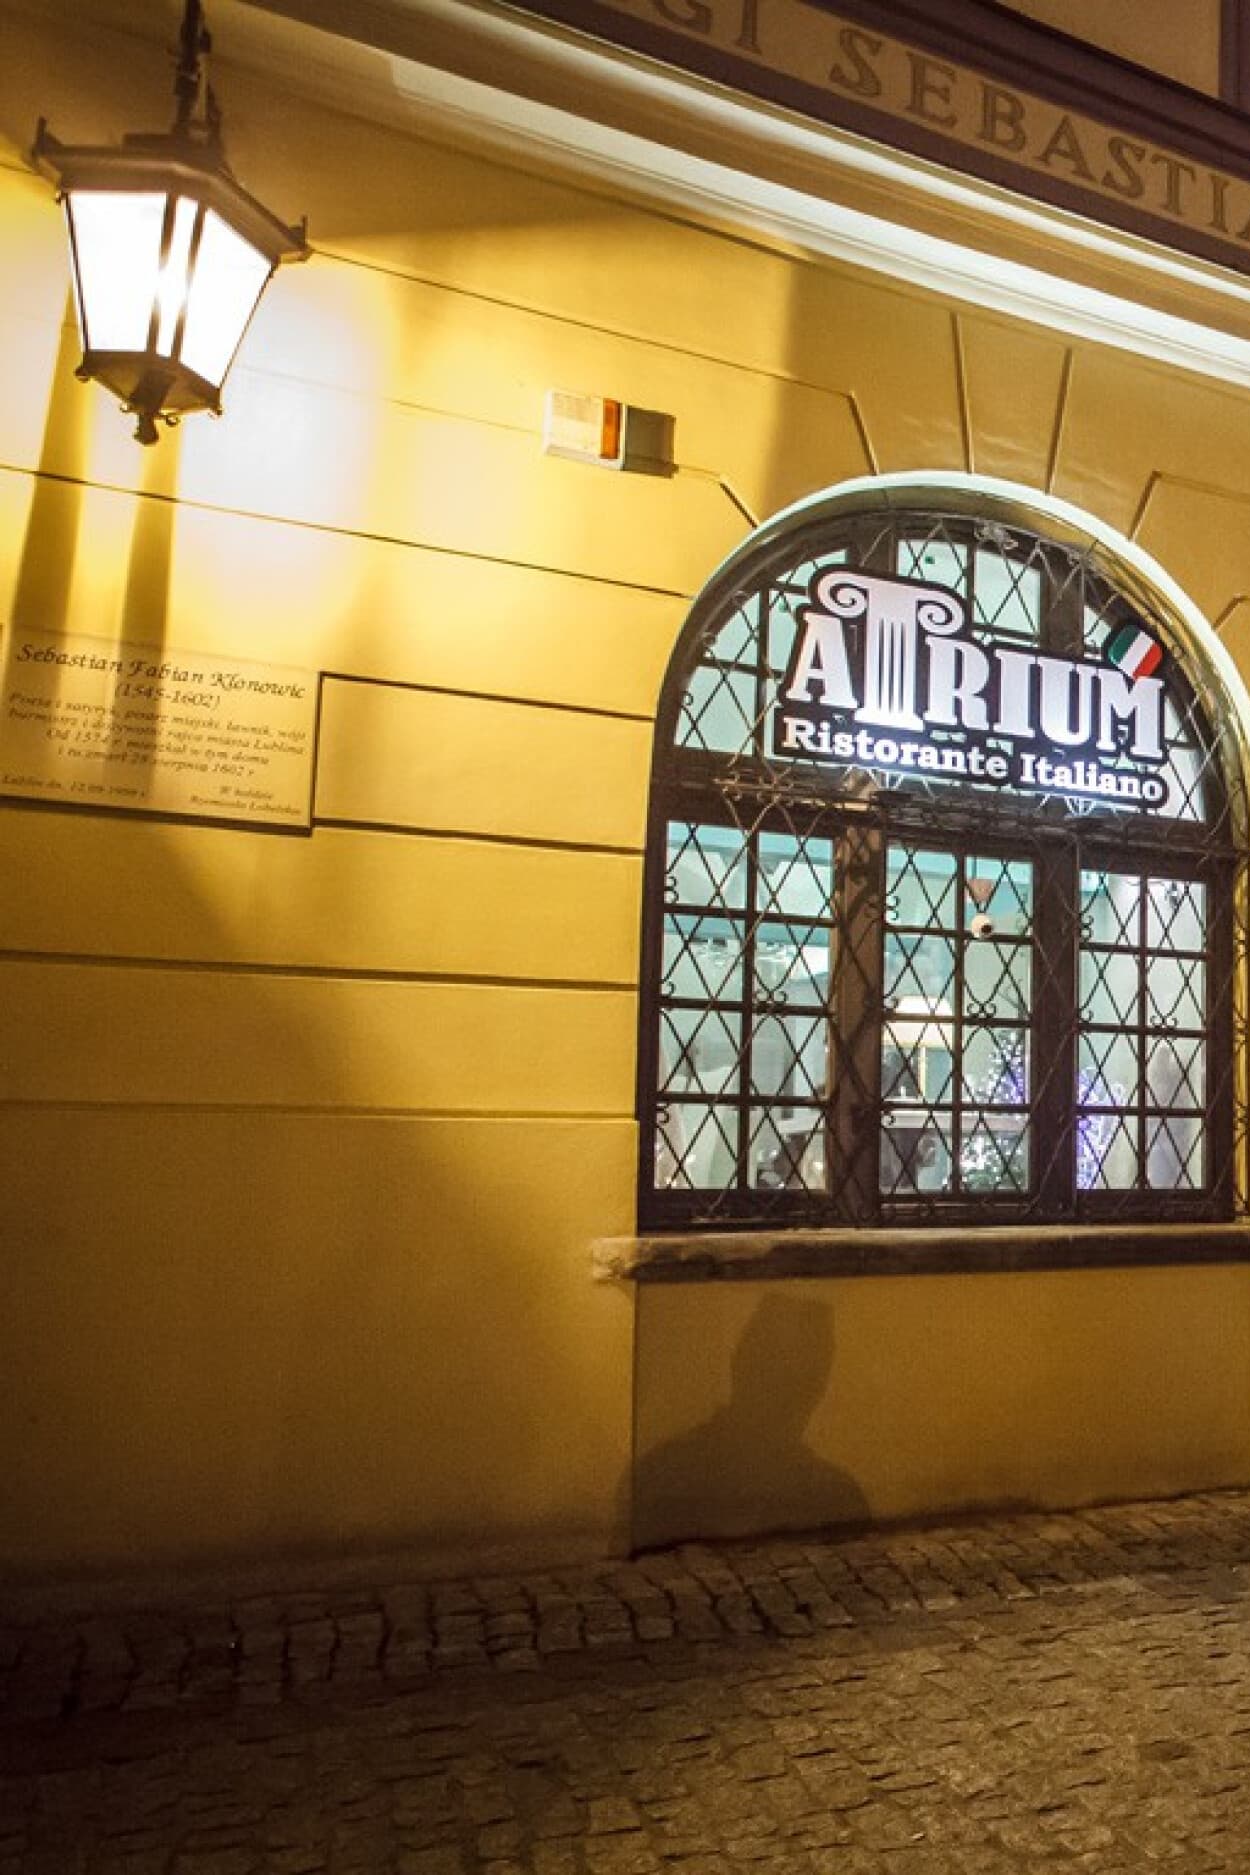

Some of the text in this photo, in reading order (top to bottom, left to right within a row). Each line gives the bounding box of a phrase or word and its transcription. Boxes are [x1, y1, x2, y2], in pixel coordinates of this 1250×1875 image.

[16, 643, 306, 699] Sebastian Fabian Klonowic
[115, 682, 221, 710] (1545-1602)
[786, 571, 1165, 759] ATRIUM
[782, 716, 1163, 802] Ristorante Italiano
